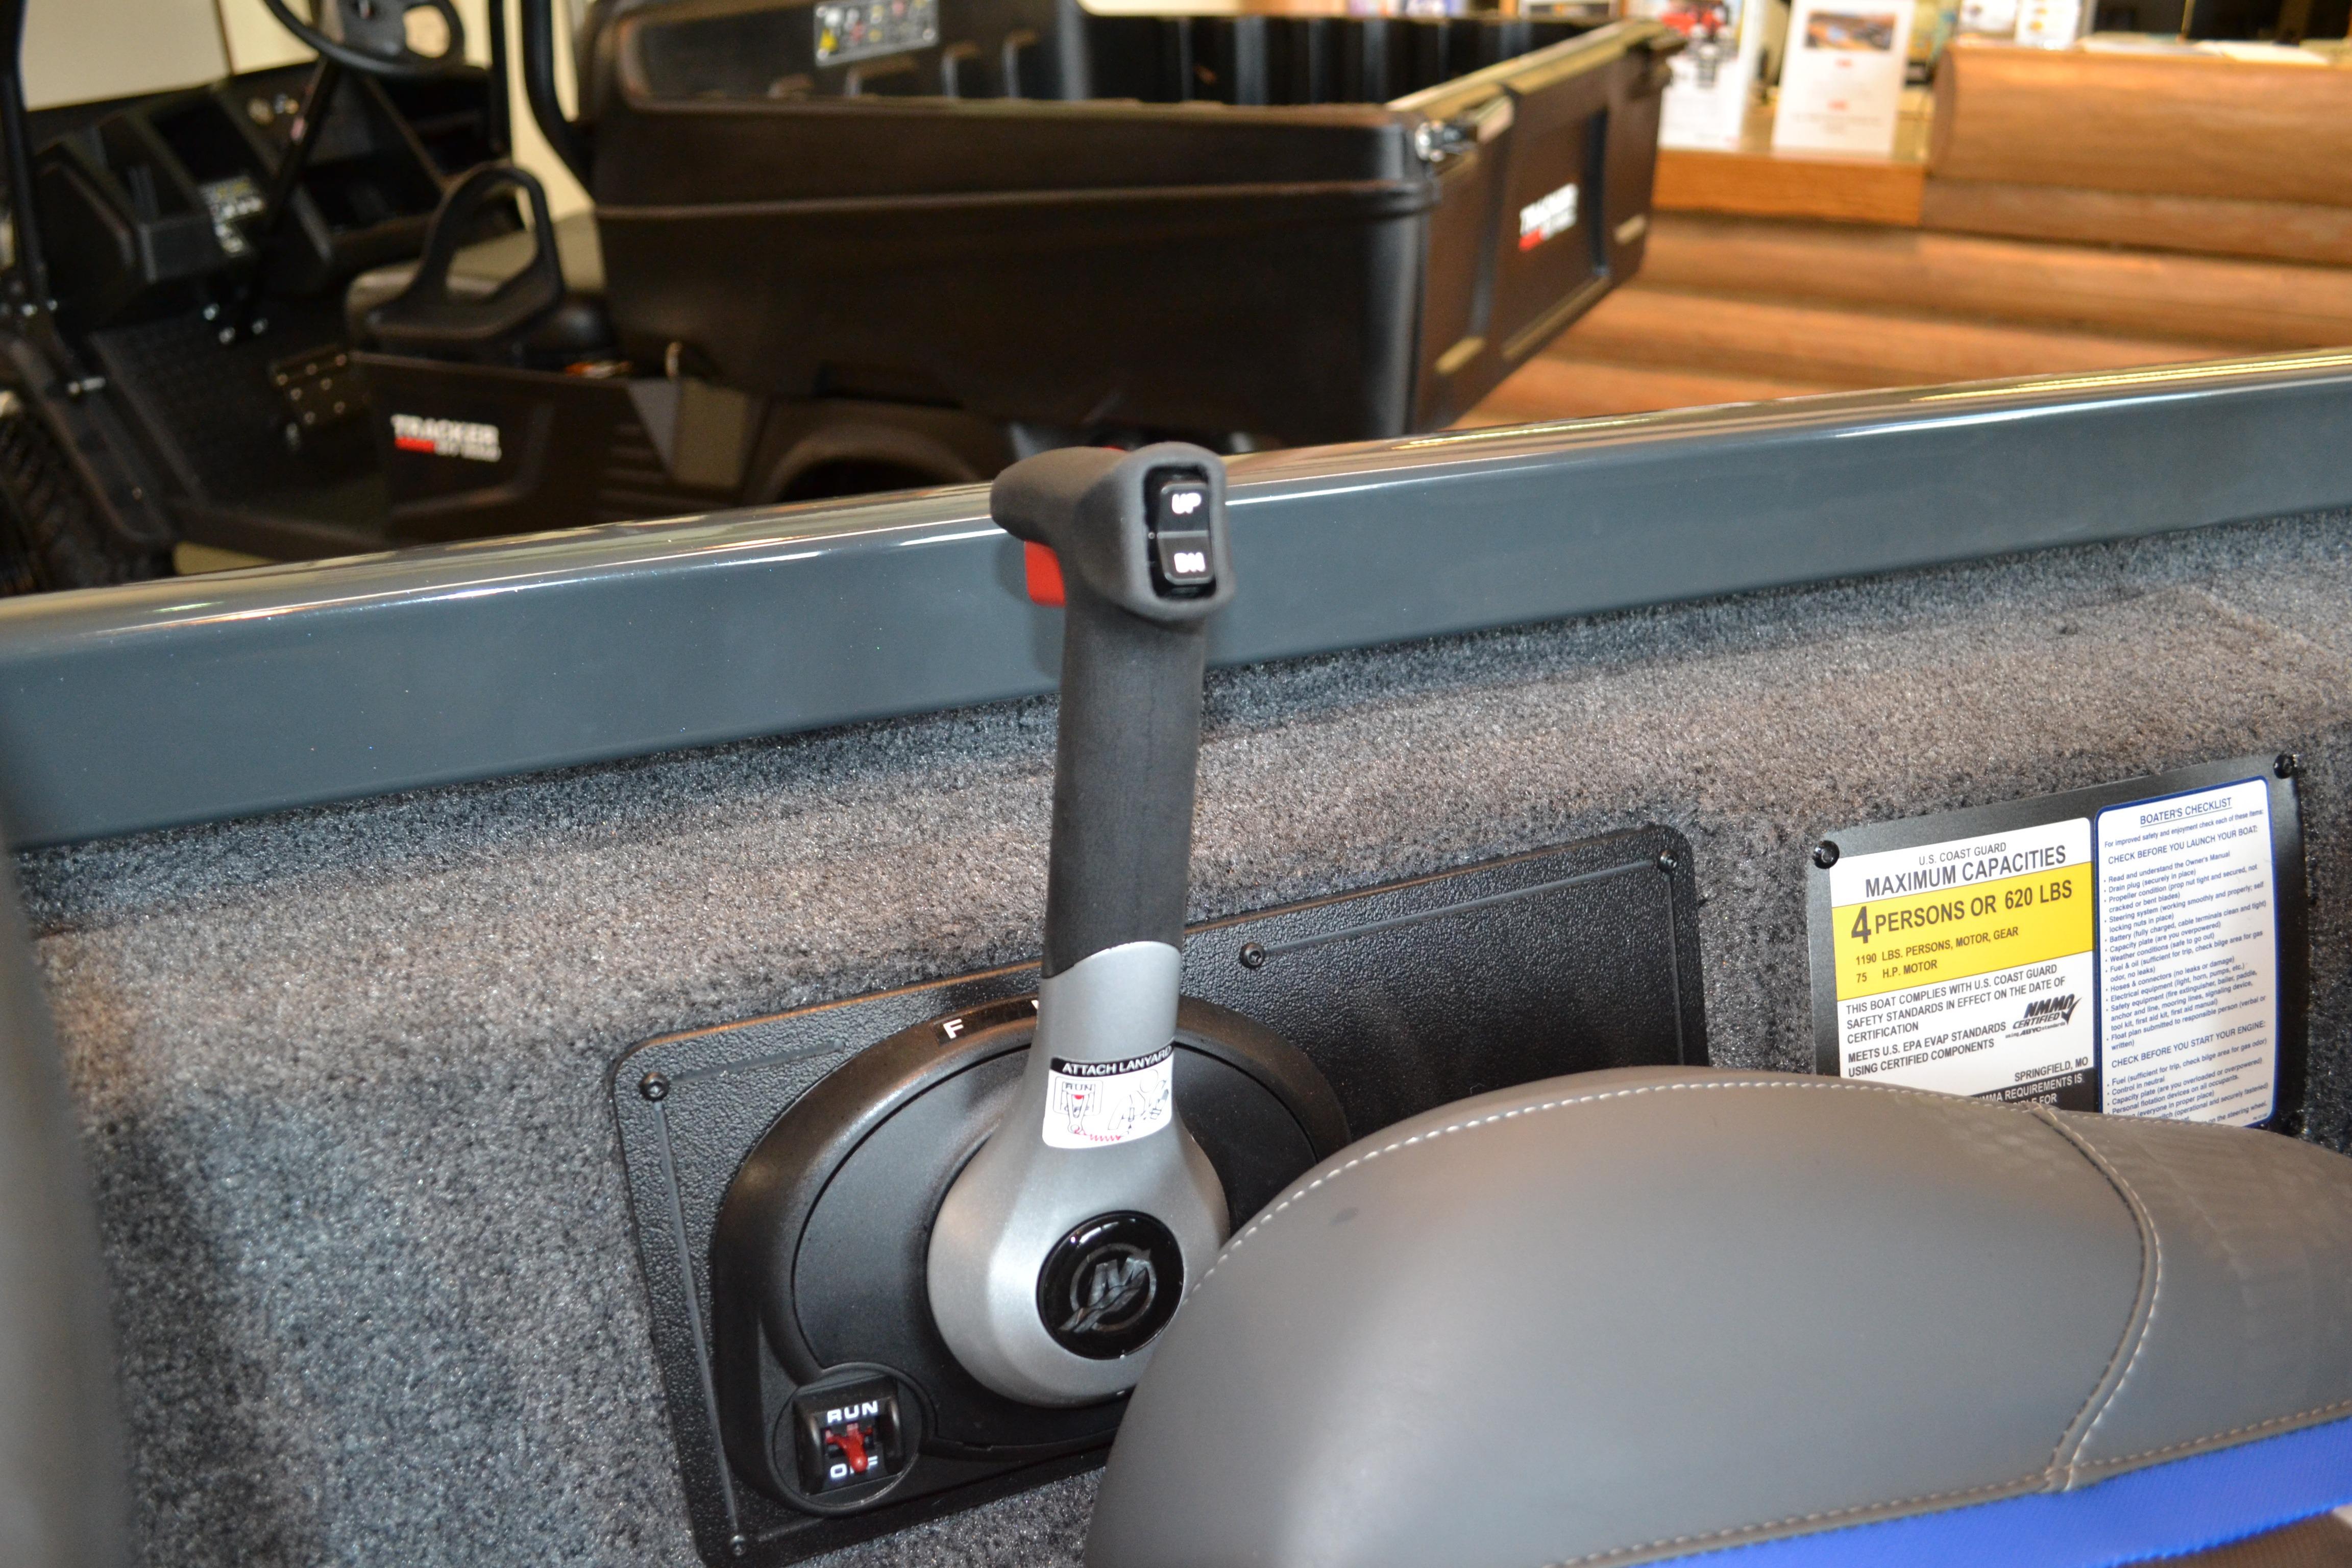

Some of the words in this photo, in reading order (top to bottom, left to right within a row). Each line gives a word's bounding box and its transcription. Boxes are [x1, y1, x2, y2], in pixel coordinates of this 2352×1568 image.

[1172, 493, 1202, 514] UP
[2141, 808, 2182, 824] BOATER'S
[2185, 797, 2231, 815] CHECKLIST
[2109, 852, 2135, 864] CHECK
[2138, 845, 2167, 858] BEFORE
[2169, 842, 2184, 851] YOU
[2187, 835, 2215, 848] LAUNCH
[2217, 830, 2236, 840] YOUR
[2239, 825, 2257, 836] BOAT:
[2116, 835, 2141, 846] improved
[2171, 823, 2198, 835] enjoyment
[1919, 854, 1936, 865] U.S.
[1940, 848, 1971, 862] COAST
[1974, 842, 2006, 856] GUARD
[1866, 865, 1955, 897] MAXIMUM
[1963, 845, 2065, 881] CAPACITIES
[2109, 874, 2124, 883] Read
[2139, 864, 2173, 876] understand
[2186, 857, 2208, 866] Owner's
[2210, 851, 2230, 861] Manual
[2109, 893, 2137, 902] Propeller
[2139, 886, 2166, 896] condition
[2196, 876, 2209, 884] tight
[2127, 882, 2140, 891] plug
[1851, 906, 1871, 943] 4
[1875, 901, 1965, 934] PERSONS
[1971, 895, 1996, 916] OR
[2005, 887, 2032, 909] 620
[2040, 880, 2072, 903] LBS
[2109, 902, 2133, 913] cracked
[2110, 913, 2135, 923] Steering
[2137, 908, 2158, 917] system
[2188, 894, 2213, 905] smoothly
[2254, 881, 2264, 889] self
[2110, 923, 2132, 933] locking
[1856, 953, 1876, 965] 1190
[1882, 949, 1902, 961] LBS.
[1906, 940, 1952, 957] PERSONS,
[1956, 933, 1991, 947] MOTOR,
[1994, 927, 2018, 940] GEAR
[2110, 942, 2136, 952] Capacity
[2139, 938, 2153, 947] plate
[2169, 932, 2179, 940] you
[2110, 952, 2135, 962] Weather
[2137, 944, 2168, 956] conditions
[1856, 972, 1867, 983] 75
[1883, 967, 1900, 978] H.P.
[1904, 960, 1937, 974] MOTOR
[1846, 1002, 1867, 1014] THIS
[1871, 997, 1896, 1010] BOAT
[1899, 987, 1946, 1004] COMPLIES
[1949, 982, 1971, 994] WITH
[1975, 978, 1991, 989] U.S.
[1994, 971, 2023, 986] COAST
[2026, 964, 2057, 978] GUARD
[1847, 1014, 1883, 1029] SAFETY
[1886, 1002, 1943, 1021] STANDARDS
[1947, 1000, 1954, 1010] IN
[1958, 992, 1991, 1007] EFFECT
[1994, 989, 2006, 999] ON
[2010, 985, 2026, 996] THE
[2029, 979, 2051, 992] DATE
[2054, 976, 2065, 987] OF
[943, 1019, 964, 1039] F
[2013, 1012, 2060, 1029] CERTIFIED
[2020, 1026, 2042, 1037] ABYC
[1848, 1021, 1918, 1044] CERTIFICATION
[1848, 1048, 1880, 1063] MEETS
[1883, 1044, 1900, 1056] U.S.
[1903, 1040, 1922, 1051] EPA
[1925, 1034, 1948, 1047] EVAP
[1952, 1022, 2006, 1041] STANDARDS
[2112, 1055, 2139, 1068] CHECK
[2141, 1046, 2171, 1060] BEFORE
[2173, 1041, 2189, 1051] YOU
[2191, 1034, 2214, 1047] START
[2216, 1028, 2236, 1039] YOUR
[2238, 1021, 2265, 1034] ENGINE:
[1062, 1063, 1117, 1076] ATTACH
[1119, 1045, 1172, 1072] LANYARD
[1849, 1063, 1877, 1077] USING
[1880, 1052, 1928, 1070] CERTIFIED
[1931, 1039, 1994, 1060] COMPONENTS
[2015, 1061, 2072, 1082] SPRINGFIELD,
[2075, 1057, 2088, 1067] MO
[1065, 1082, 1092, 1091] RUN
[2005, 1075, 2072, 1100] REQUIREMENTS
[2074, 1073, 2082, 1084] IS
[2112, 1084, 2135, 1095] Control
[2144, 1076, 2165, 1087] neutral
[2040, 1093, 2057, 1105] FOR
[2112, 1102, 2139, 1116] Personal
[2141, 1096, 2165, 1107] flotation
[2167, 1089, 2190, 1099] devices
[2227, 1108, 2249, 1118] steering
[827, 1400, 878, 1423] RUN
